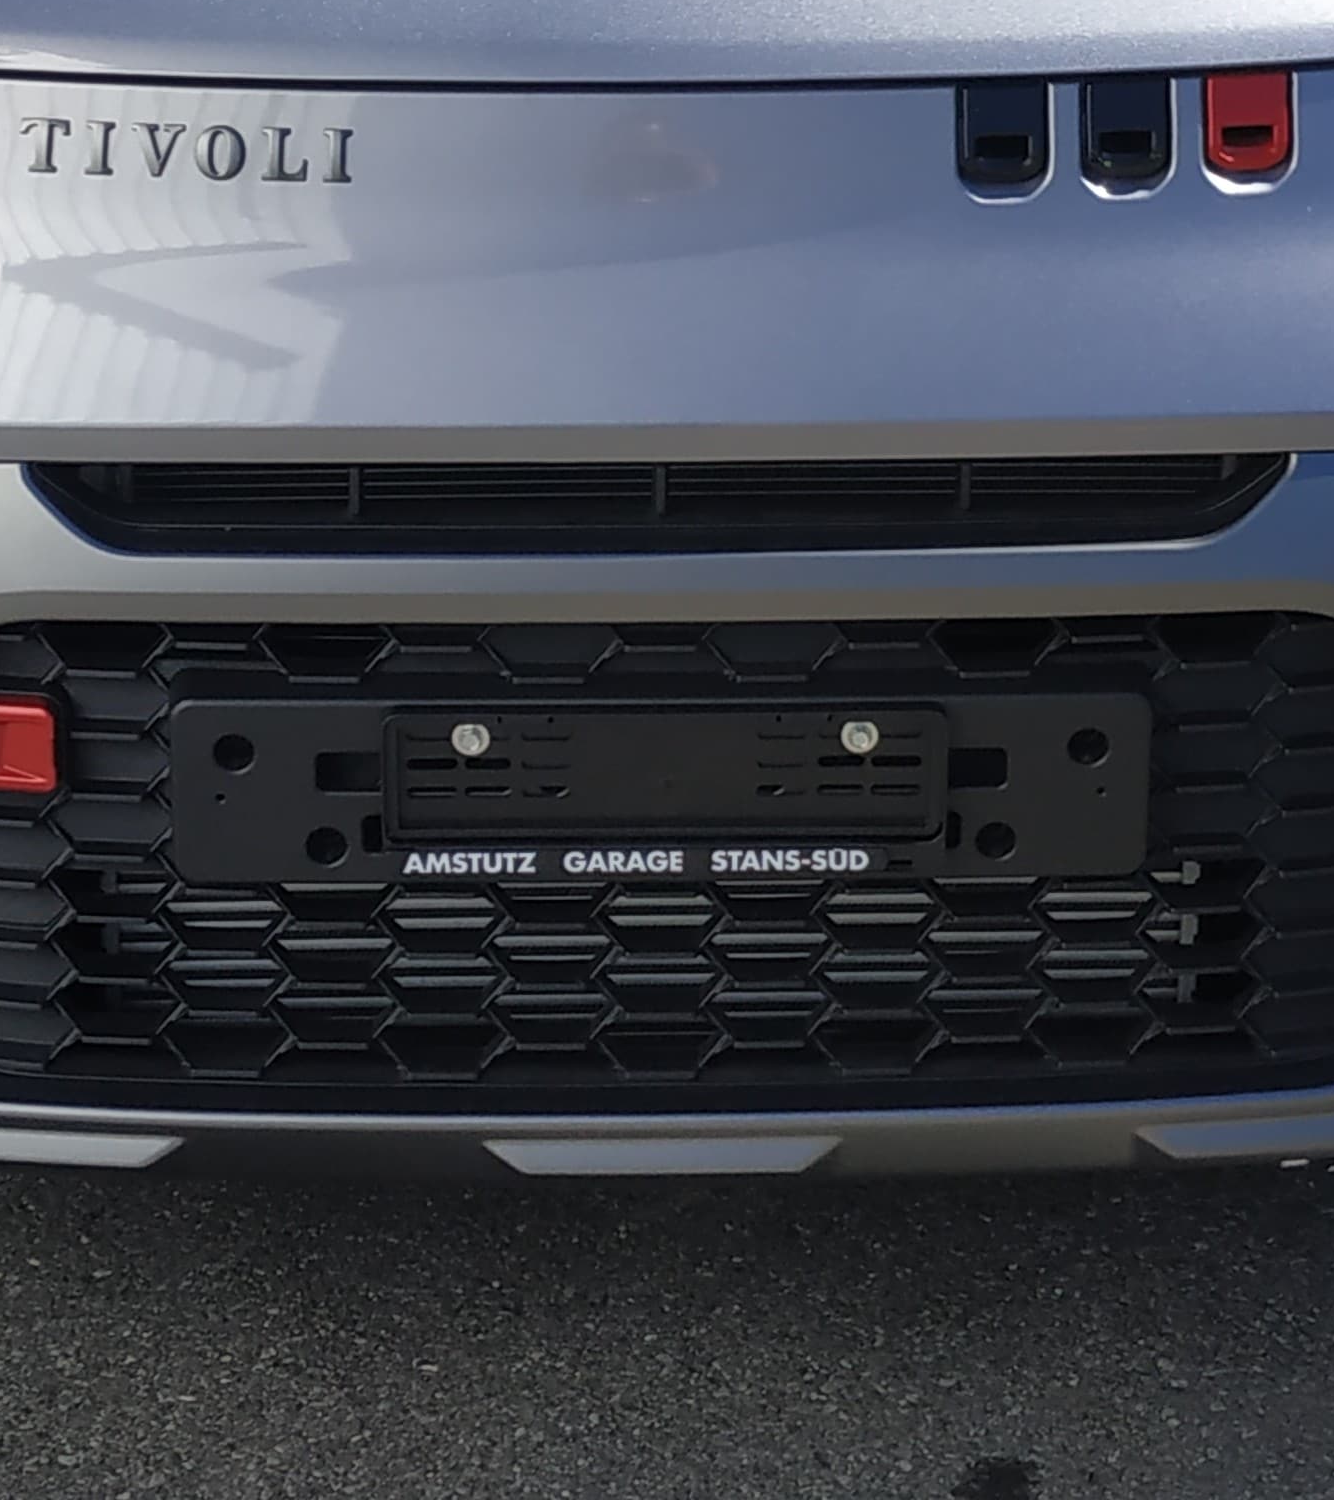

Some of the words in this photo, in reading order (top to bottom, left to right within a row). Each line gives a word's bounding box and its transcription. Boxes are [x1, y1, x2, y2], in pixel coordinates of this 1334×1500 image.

[19, 116, 355, 184] TIVOLI
[403, 851, 537, 875] AMSTUTZ
[563, 850, 684, 873] GARAGE
[711, 847, 870, 872] STANS-SÜD
